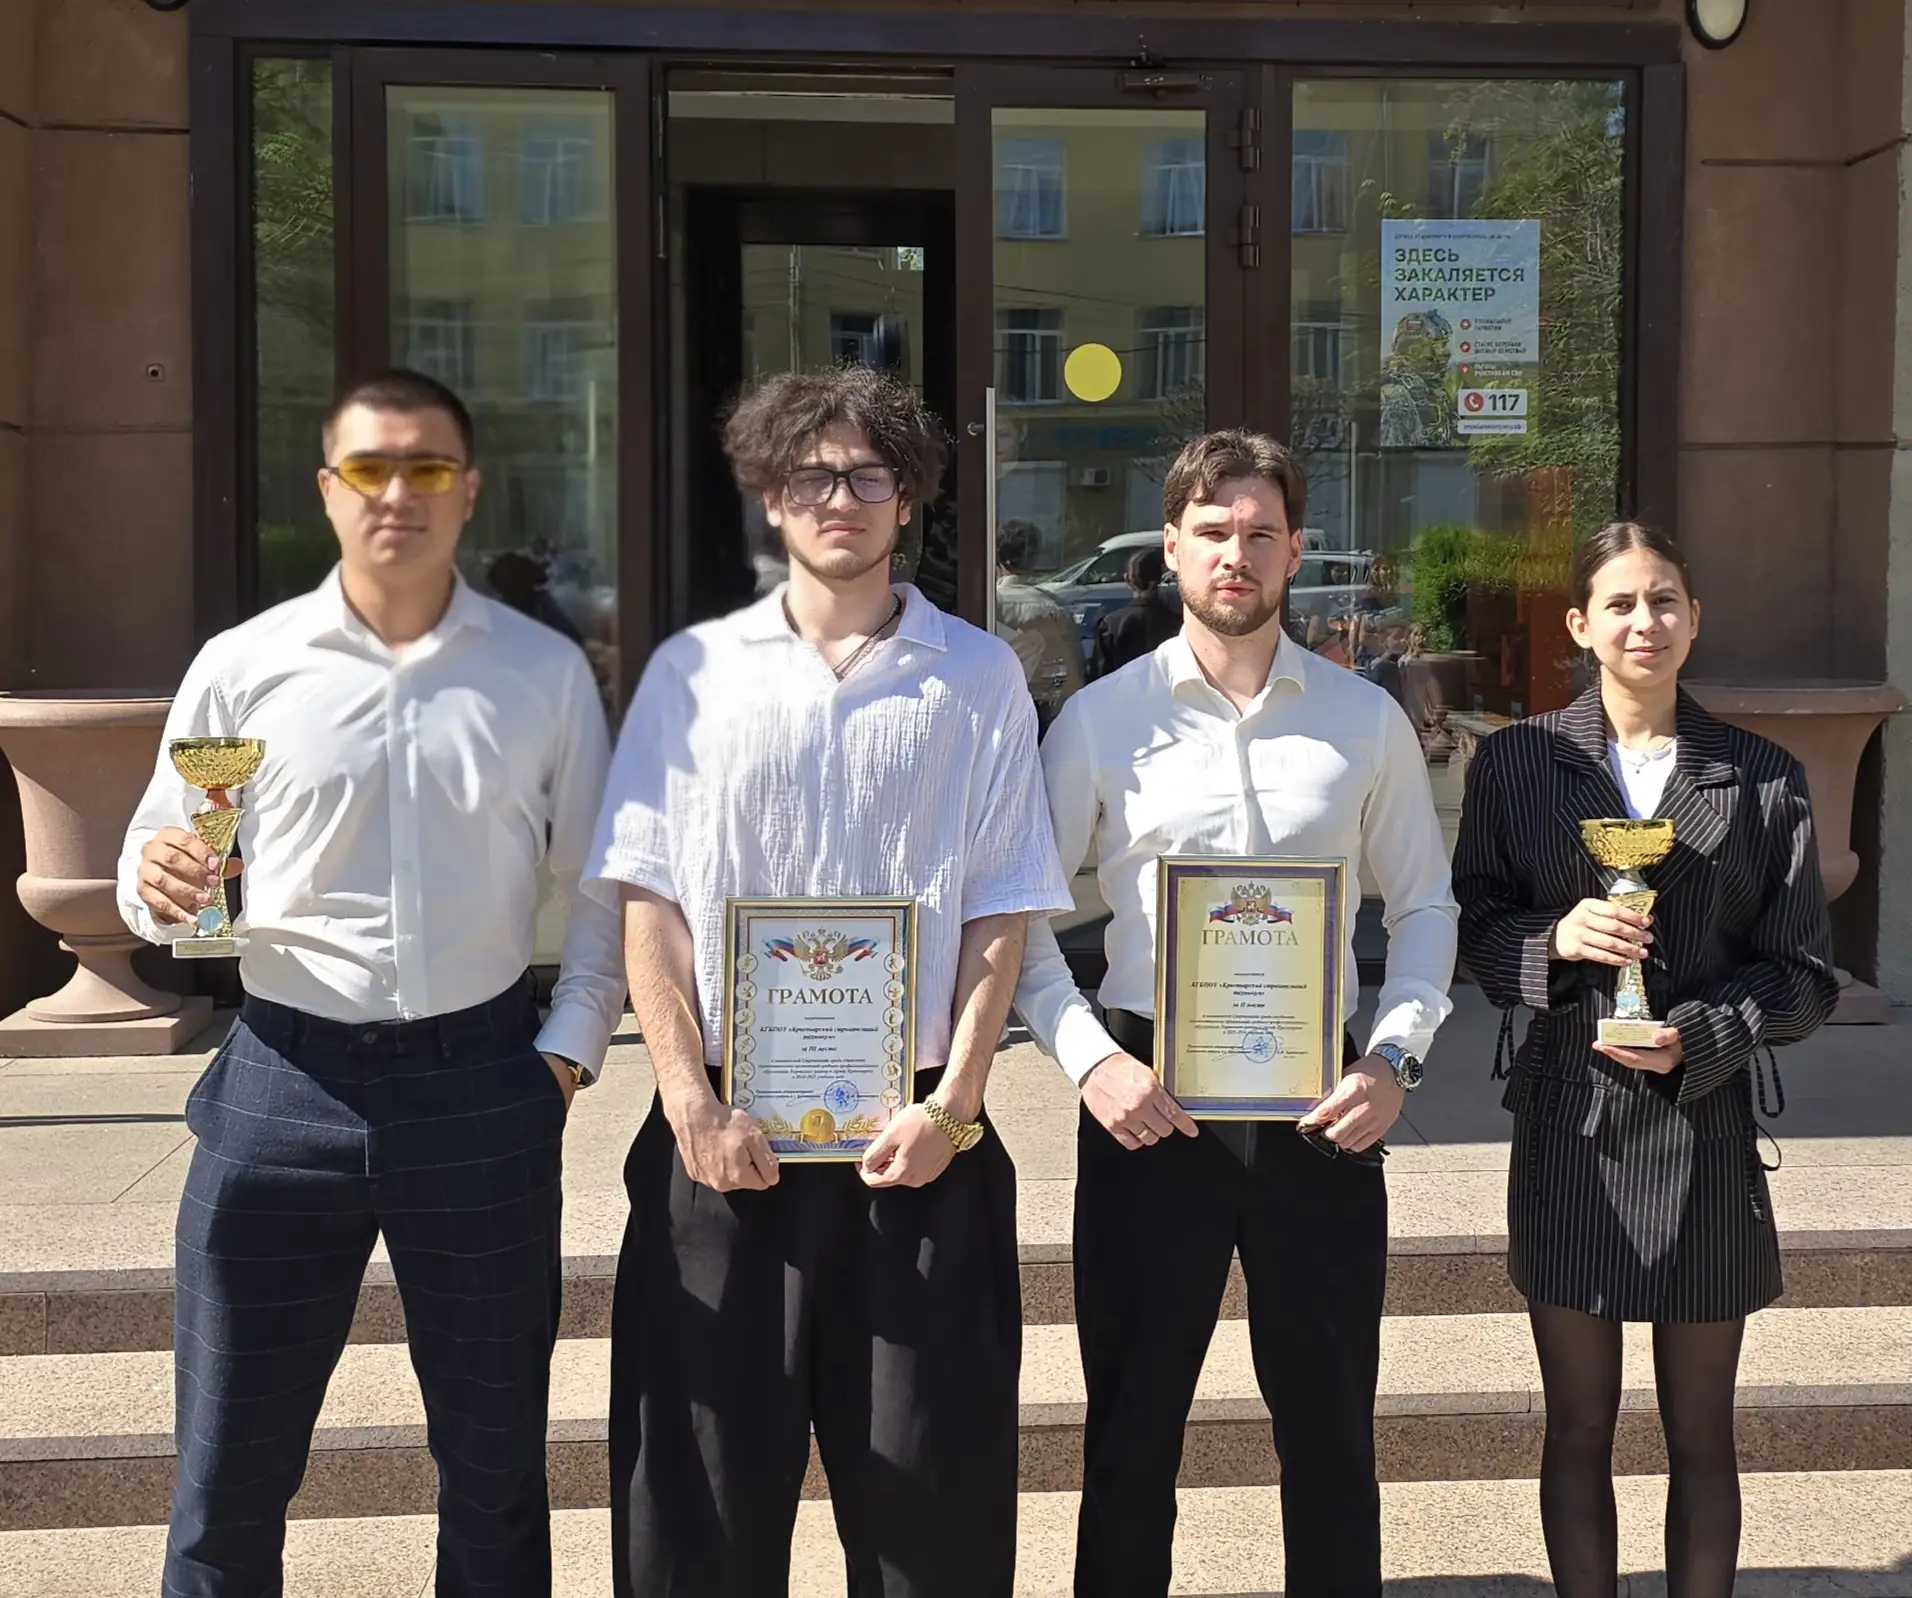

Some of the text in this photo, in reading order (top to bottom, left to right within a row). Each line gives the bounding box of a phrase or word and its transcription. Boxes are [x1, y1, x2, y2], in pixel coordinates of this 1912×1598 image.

[1395, 248, 1459, 265] ЗДЕСЬ
[1395, 268, 1524, 282] ЗАКАЛЯЕТСЯ
[1395, 287, 1495, 301] ХАРАКТЕР
[1488, 394, 1520, 411] 117
[1201, 929, 1299, 946] ГРАМОТА
[767, 988, 873, 1005] ГРАМОТА
